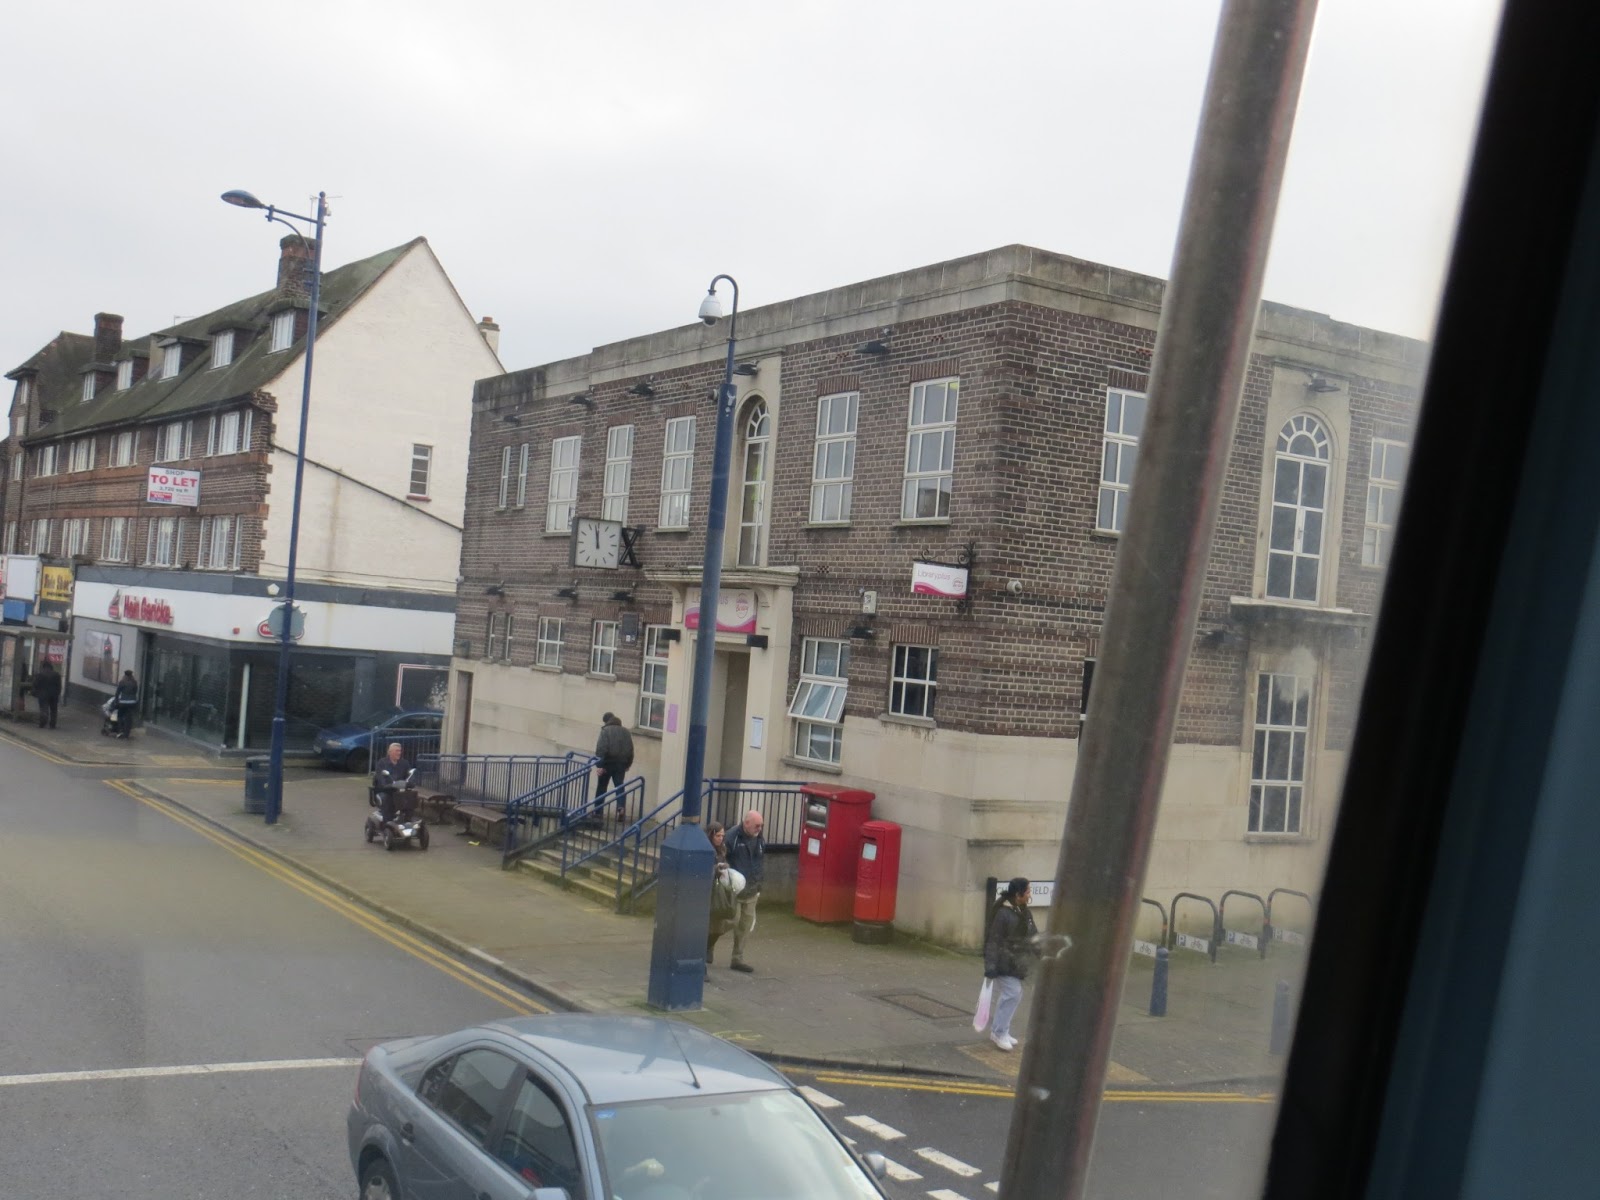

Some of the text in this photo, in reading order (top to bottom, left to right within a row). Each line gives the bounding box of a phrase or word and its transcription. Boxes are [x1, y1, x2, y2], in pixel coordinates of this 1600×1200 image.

[151, 475, 197, 487] TO LET
[124, 595, 140, 618] Hein
